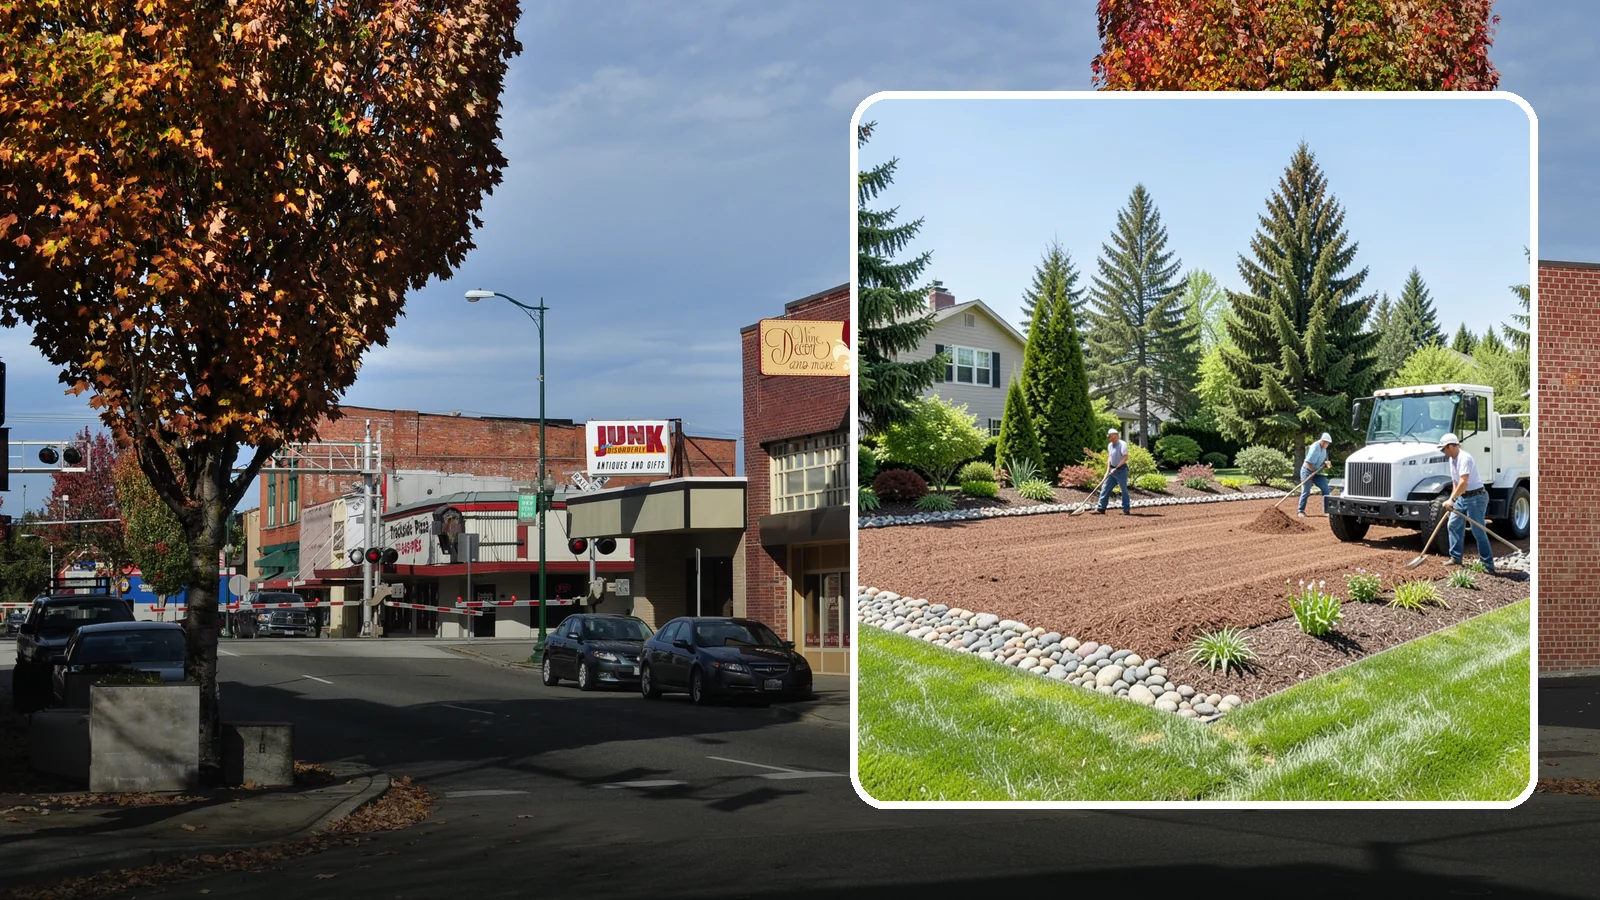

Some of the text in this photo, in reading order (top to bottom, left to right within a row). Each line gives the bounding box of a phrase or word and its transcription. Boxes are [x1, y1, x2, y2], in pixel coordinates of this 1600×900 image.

[765, 328, 830, 365] Decor
[595, 425, 665, 457] JUNK
[607, 446, 646, 454] DISORDERLY
[597, 460, 665, 470] ANTIQUES AND GIFTS
[573, 473, 589, 492] RAIL
[390, 519, 429, 540] Trackside Pizza
